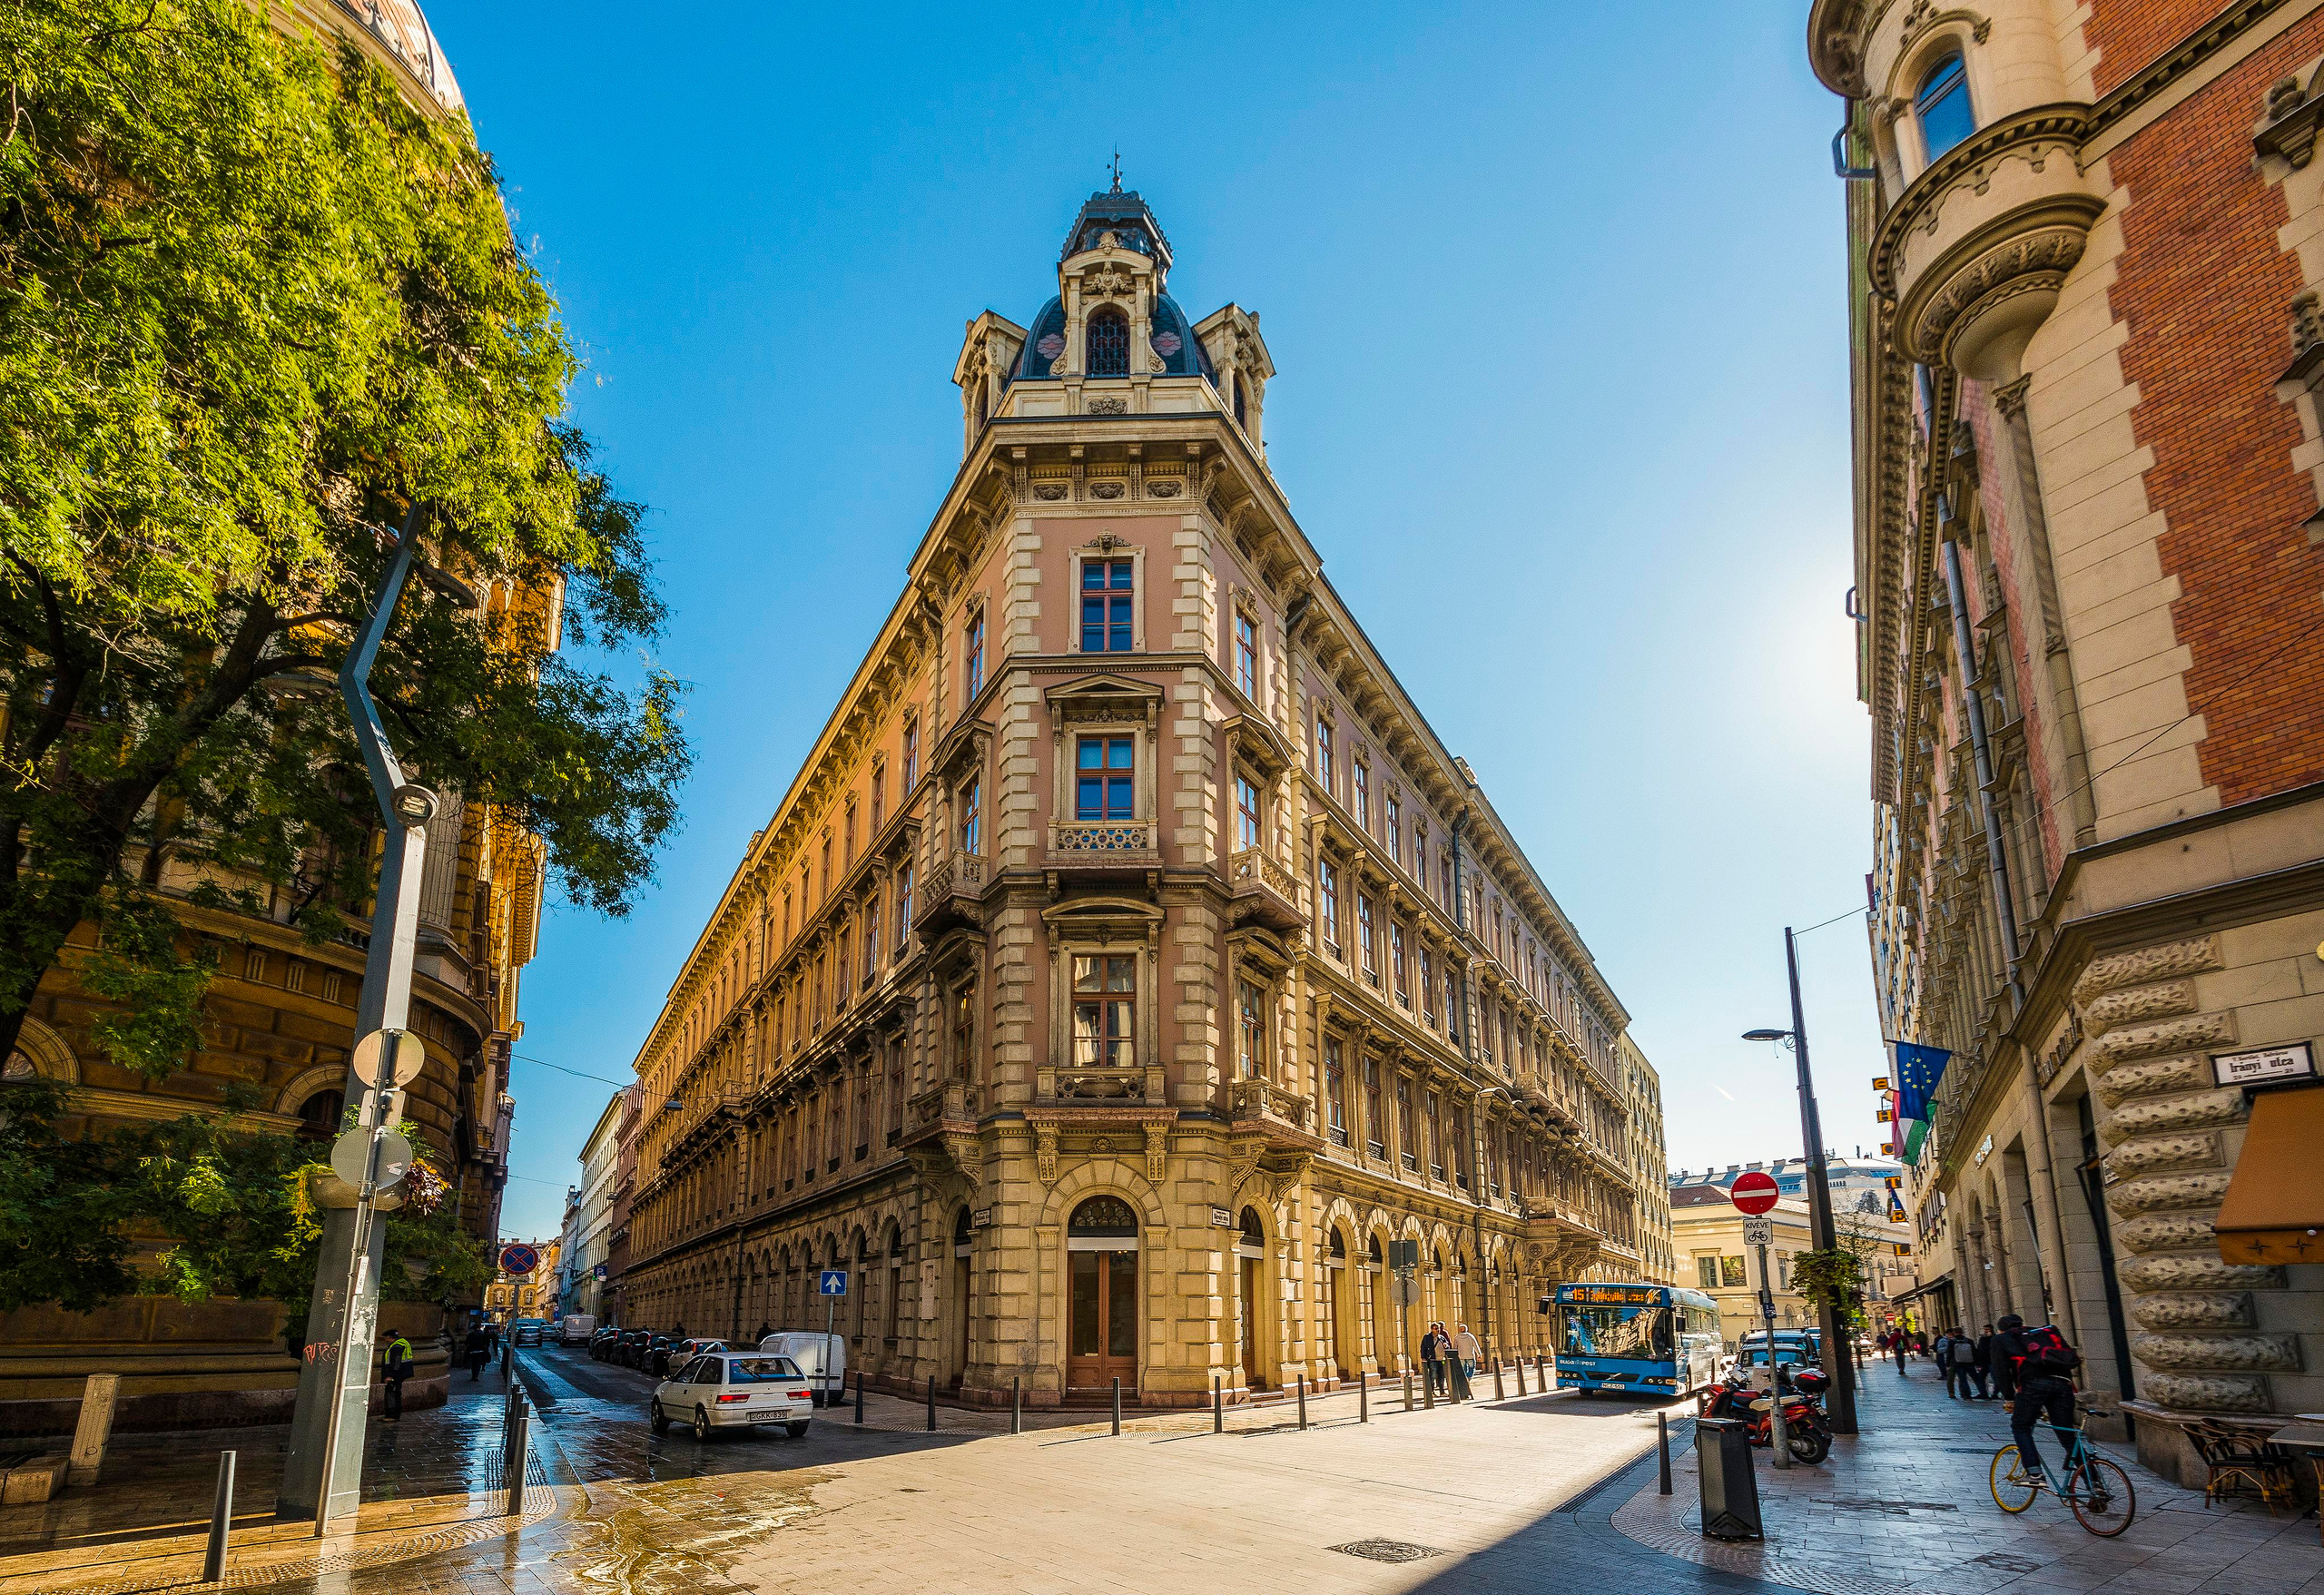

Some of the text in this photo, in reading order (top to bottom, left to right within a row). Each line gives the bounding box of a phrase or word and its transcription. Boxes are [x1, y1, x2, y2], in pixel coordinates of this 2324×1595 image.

[2230, 1056, 2294, 1073] Irányi utca
[1745, 1220, 1769, 1229] KIVÉVE
[1572, 1288, 1585, 1301] 15
